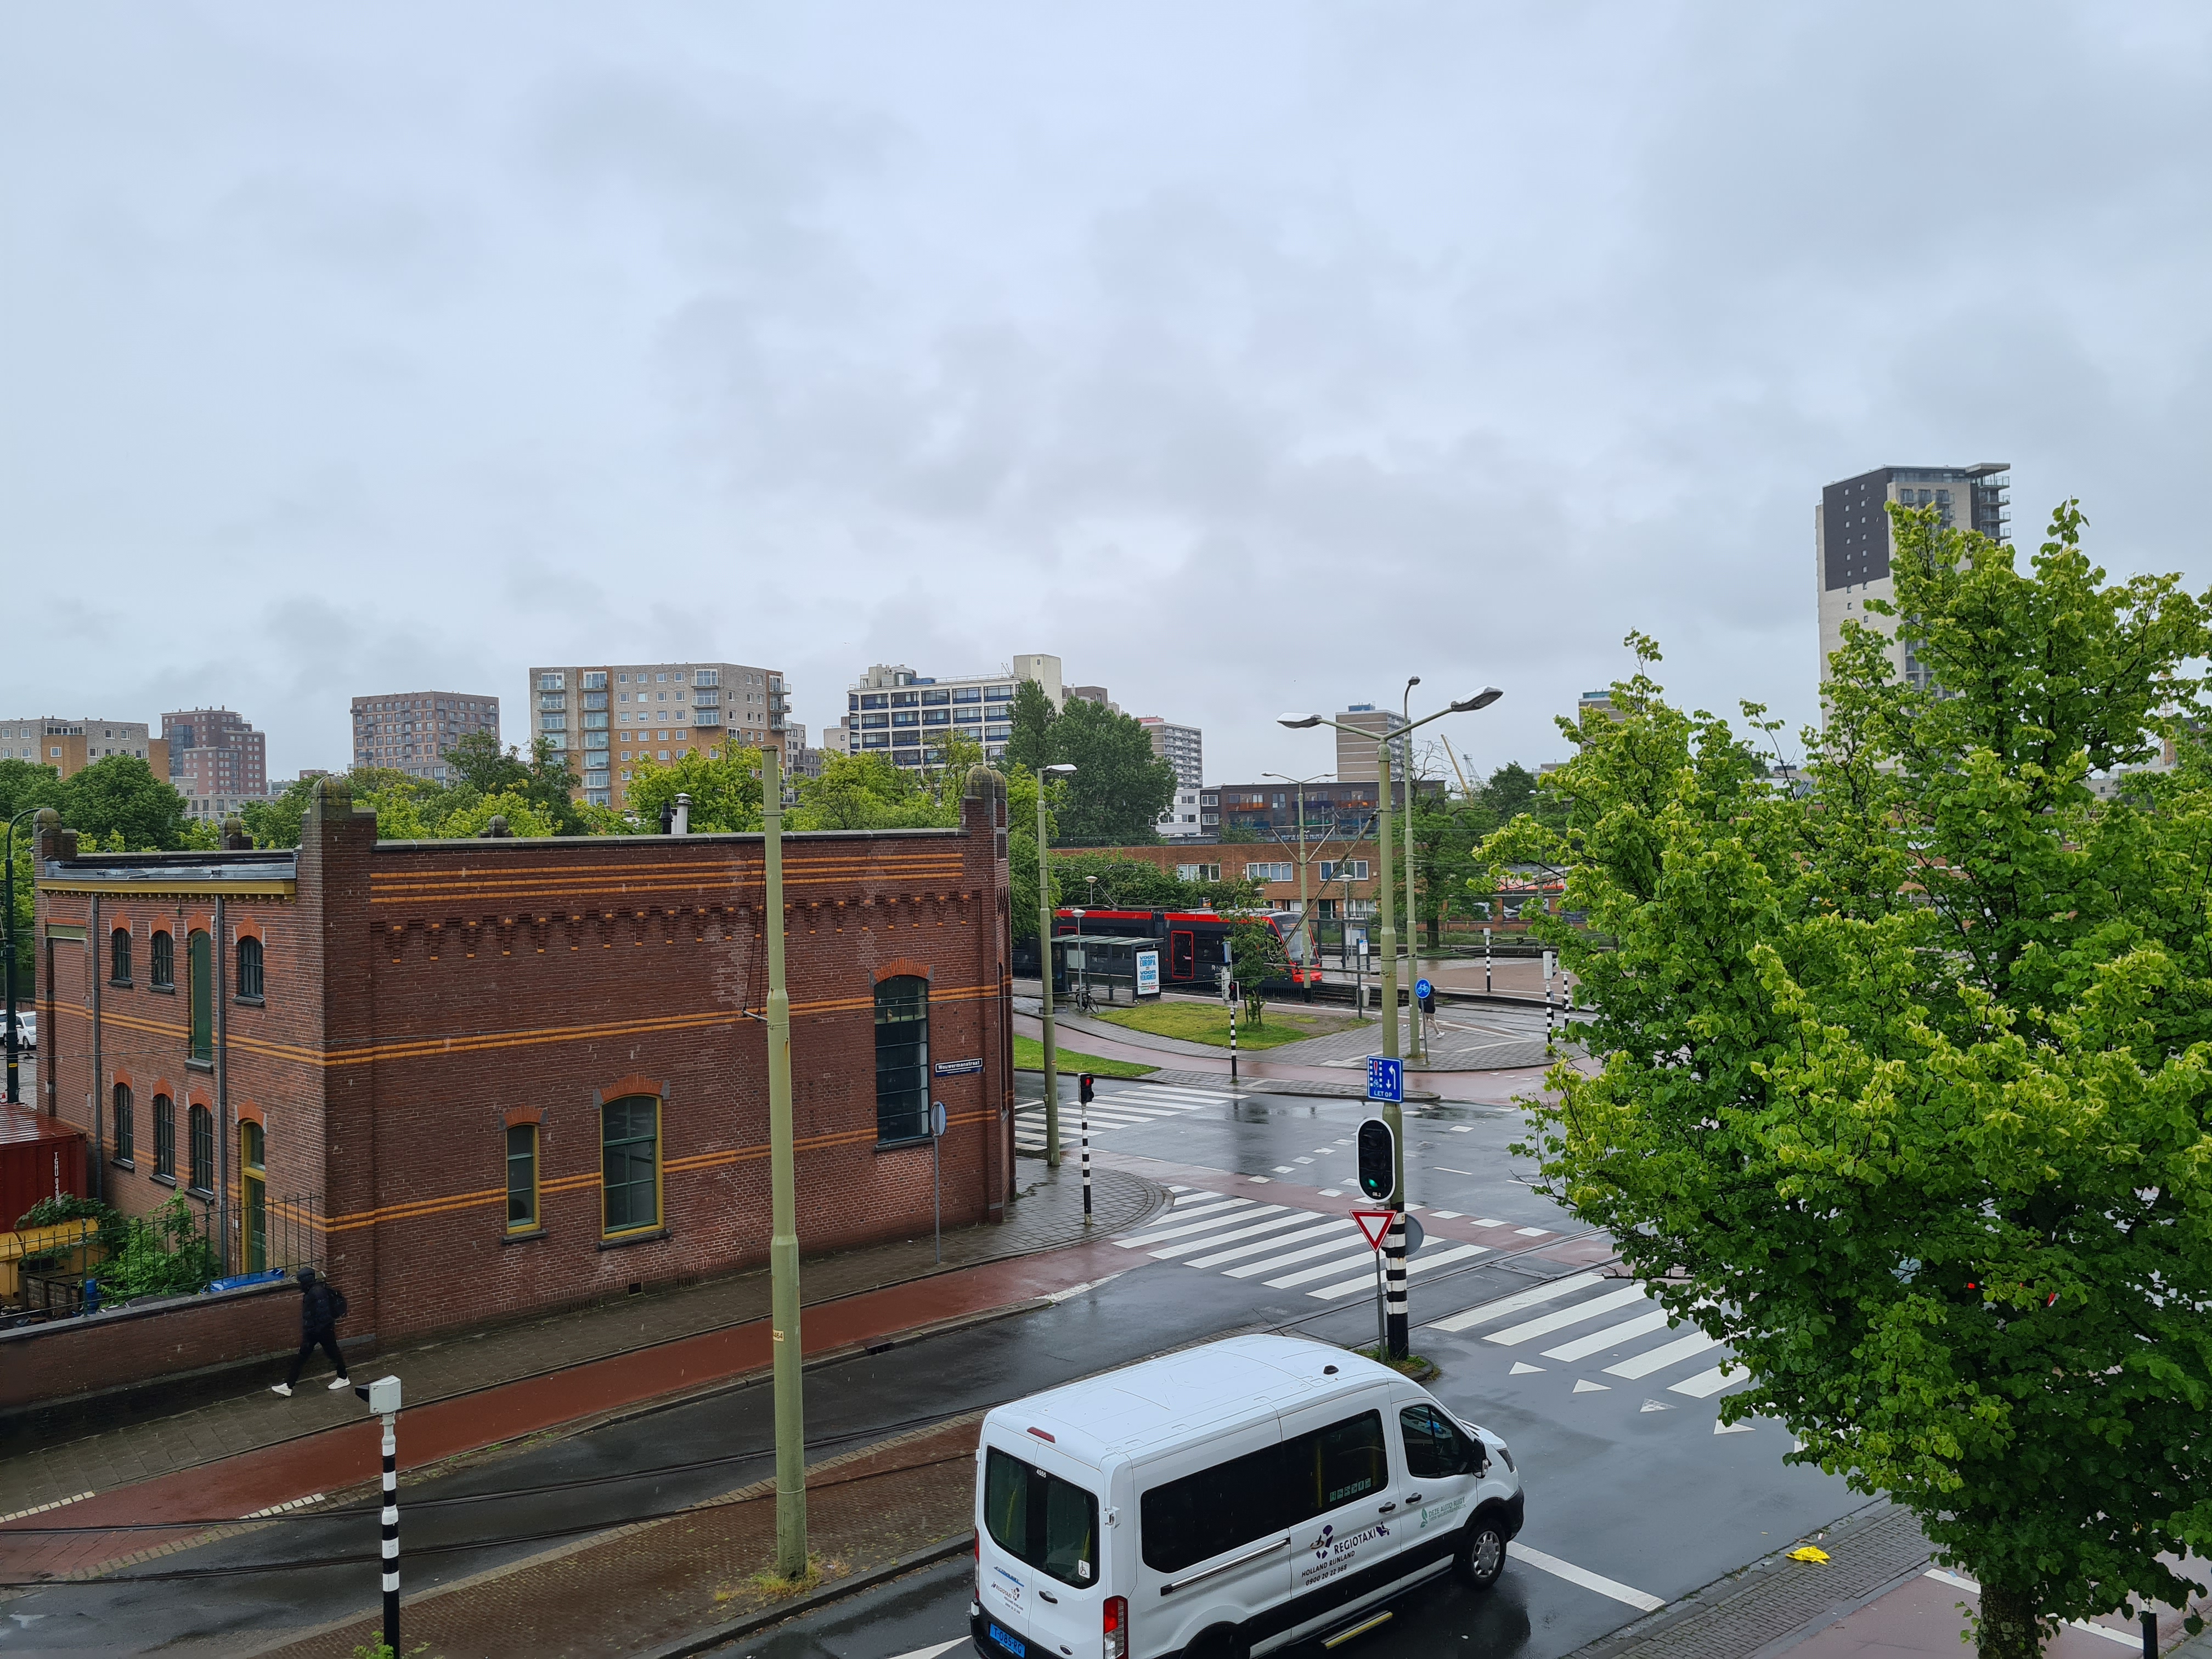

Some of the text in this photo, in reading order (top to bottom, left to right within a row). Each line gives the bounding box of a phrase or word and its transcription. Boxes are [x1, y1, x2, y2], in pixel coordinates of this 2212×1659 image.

[938, 1060, 980, 1070] Wouwermanstraat
[1429, 1507, 1440, 1517] DEZE
[1441, 1502, 1453, 1512] AUTO
[1334, 1528, 1376, 1555] REGIOTAXI
[1301, 1550, 1355, 1578] HOLLAND RIJNLAND
[1306, 1575, 1321, 1586] 0900
[1338, 1564, 1347, 1573] 368
[994, 1627, 1022, 1654] T-085-RG
